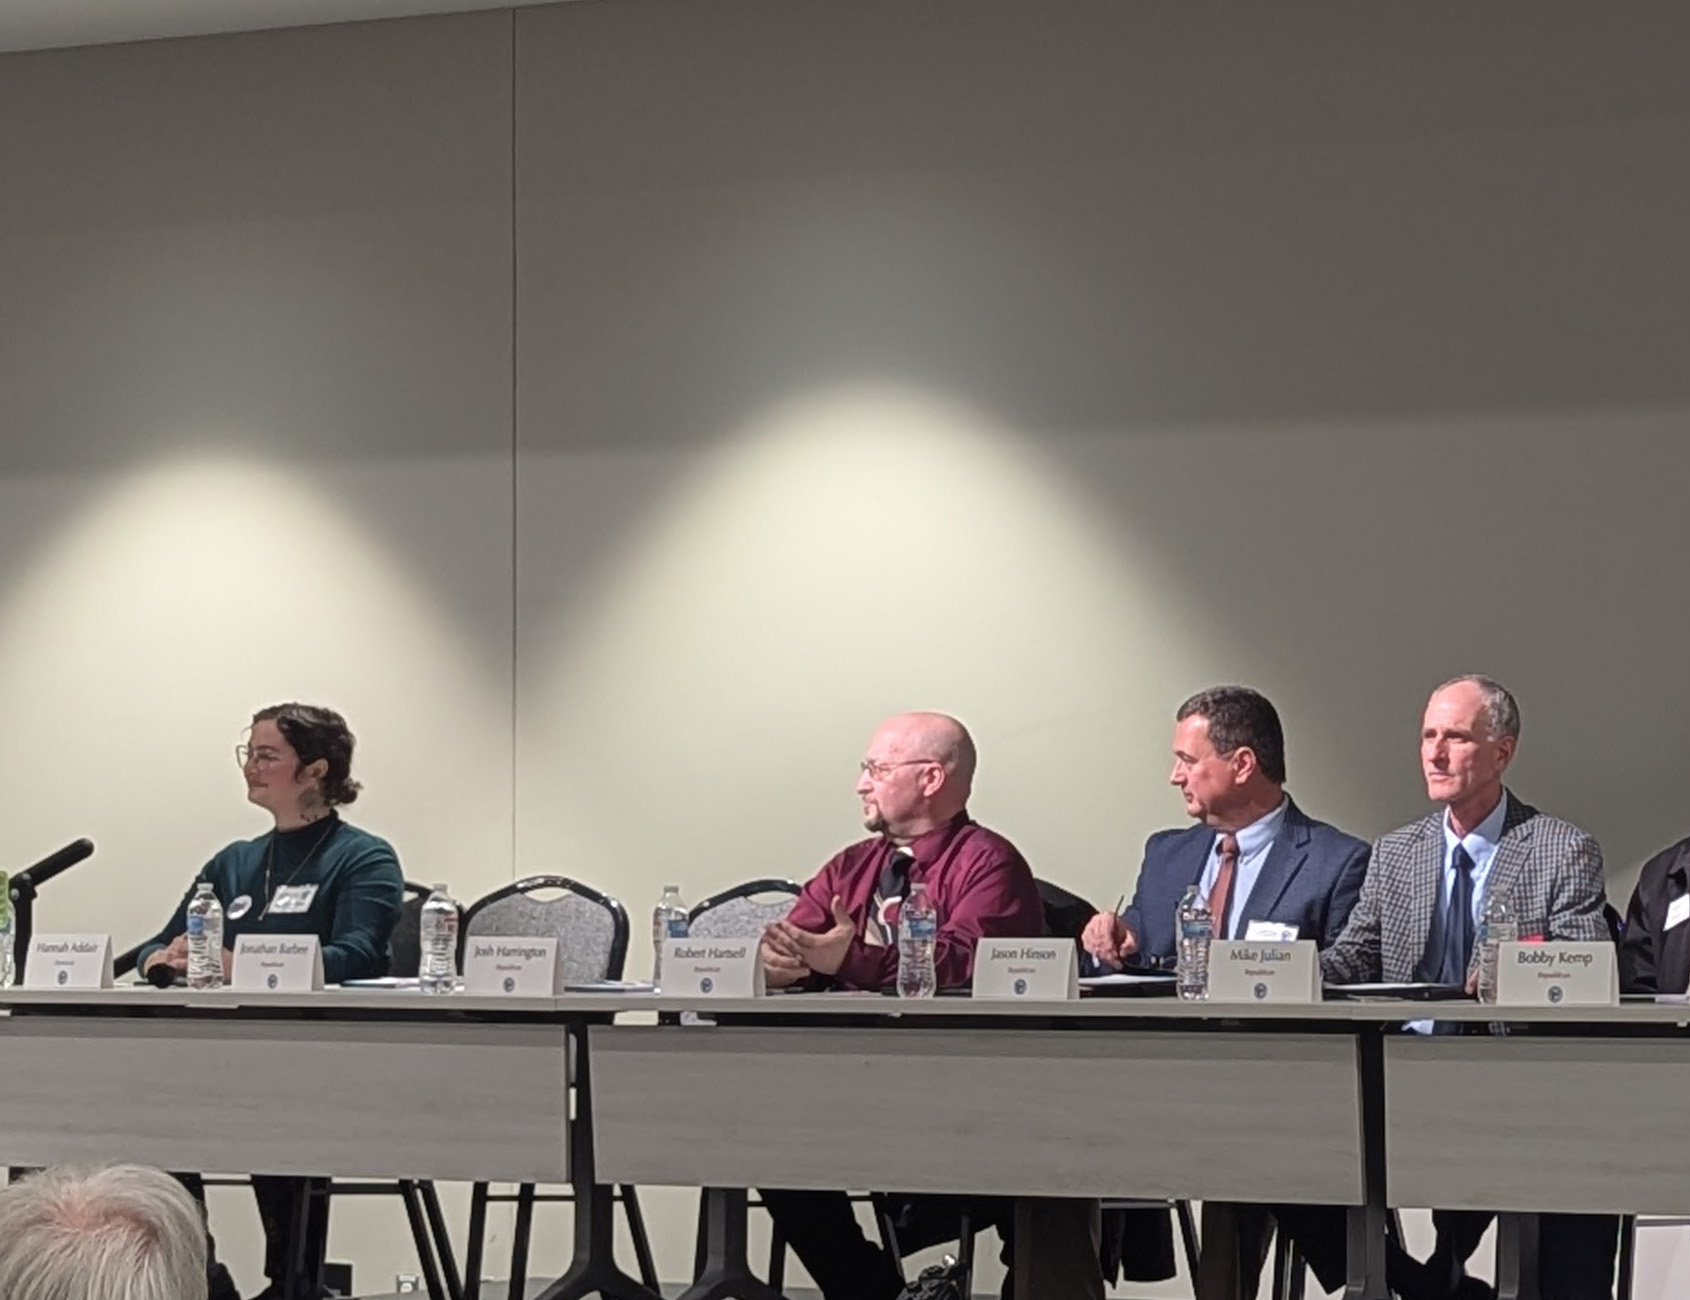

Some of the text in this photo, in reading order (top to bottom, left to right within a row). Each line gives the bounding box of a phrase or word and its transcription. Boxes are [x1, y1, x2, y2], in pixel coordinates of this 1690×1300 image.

[240, 943, 278, 955] Jonathan
[474, 945, 547, 960] Josh Harrington
[674, 946, 747, 958] Robert Hartsell
[991, 948, 1057, 960] Jason Hinson
[1230, 949, 1292, 963] Mike Julian
[1517, 951, 1594, 967] Bobby Kemp
